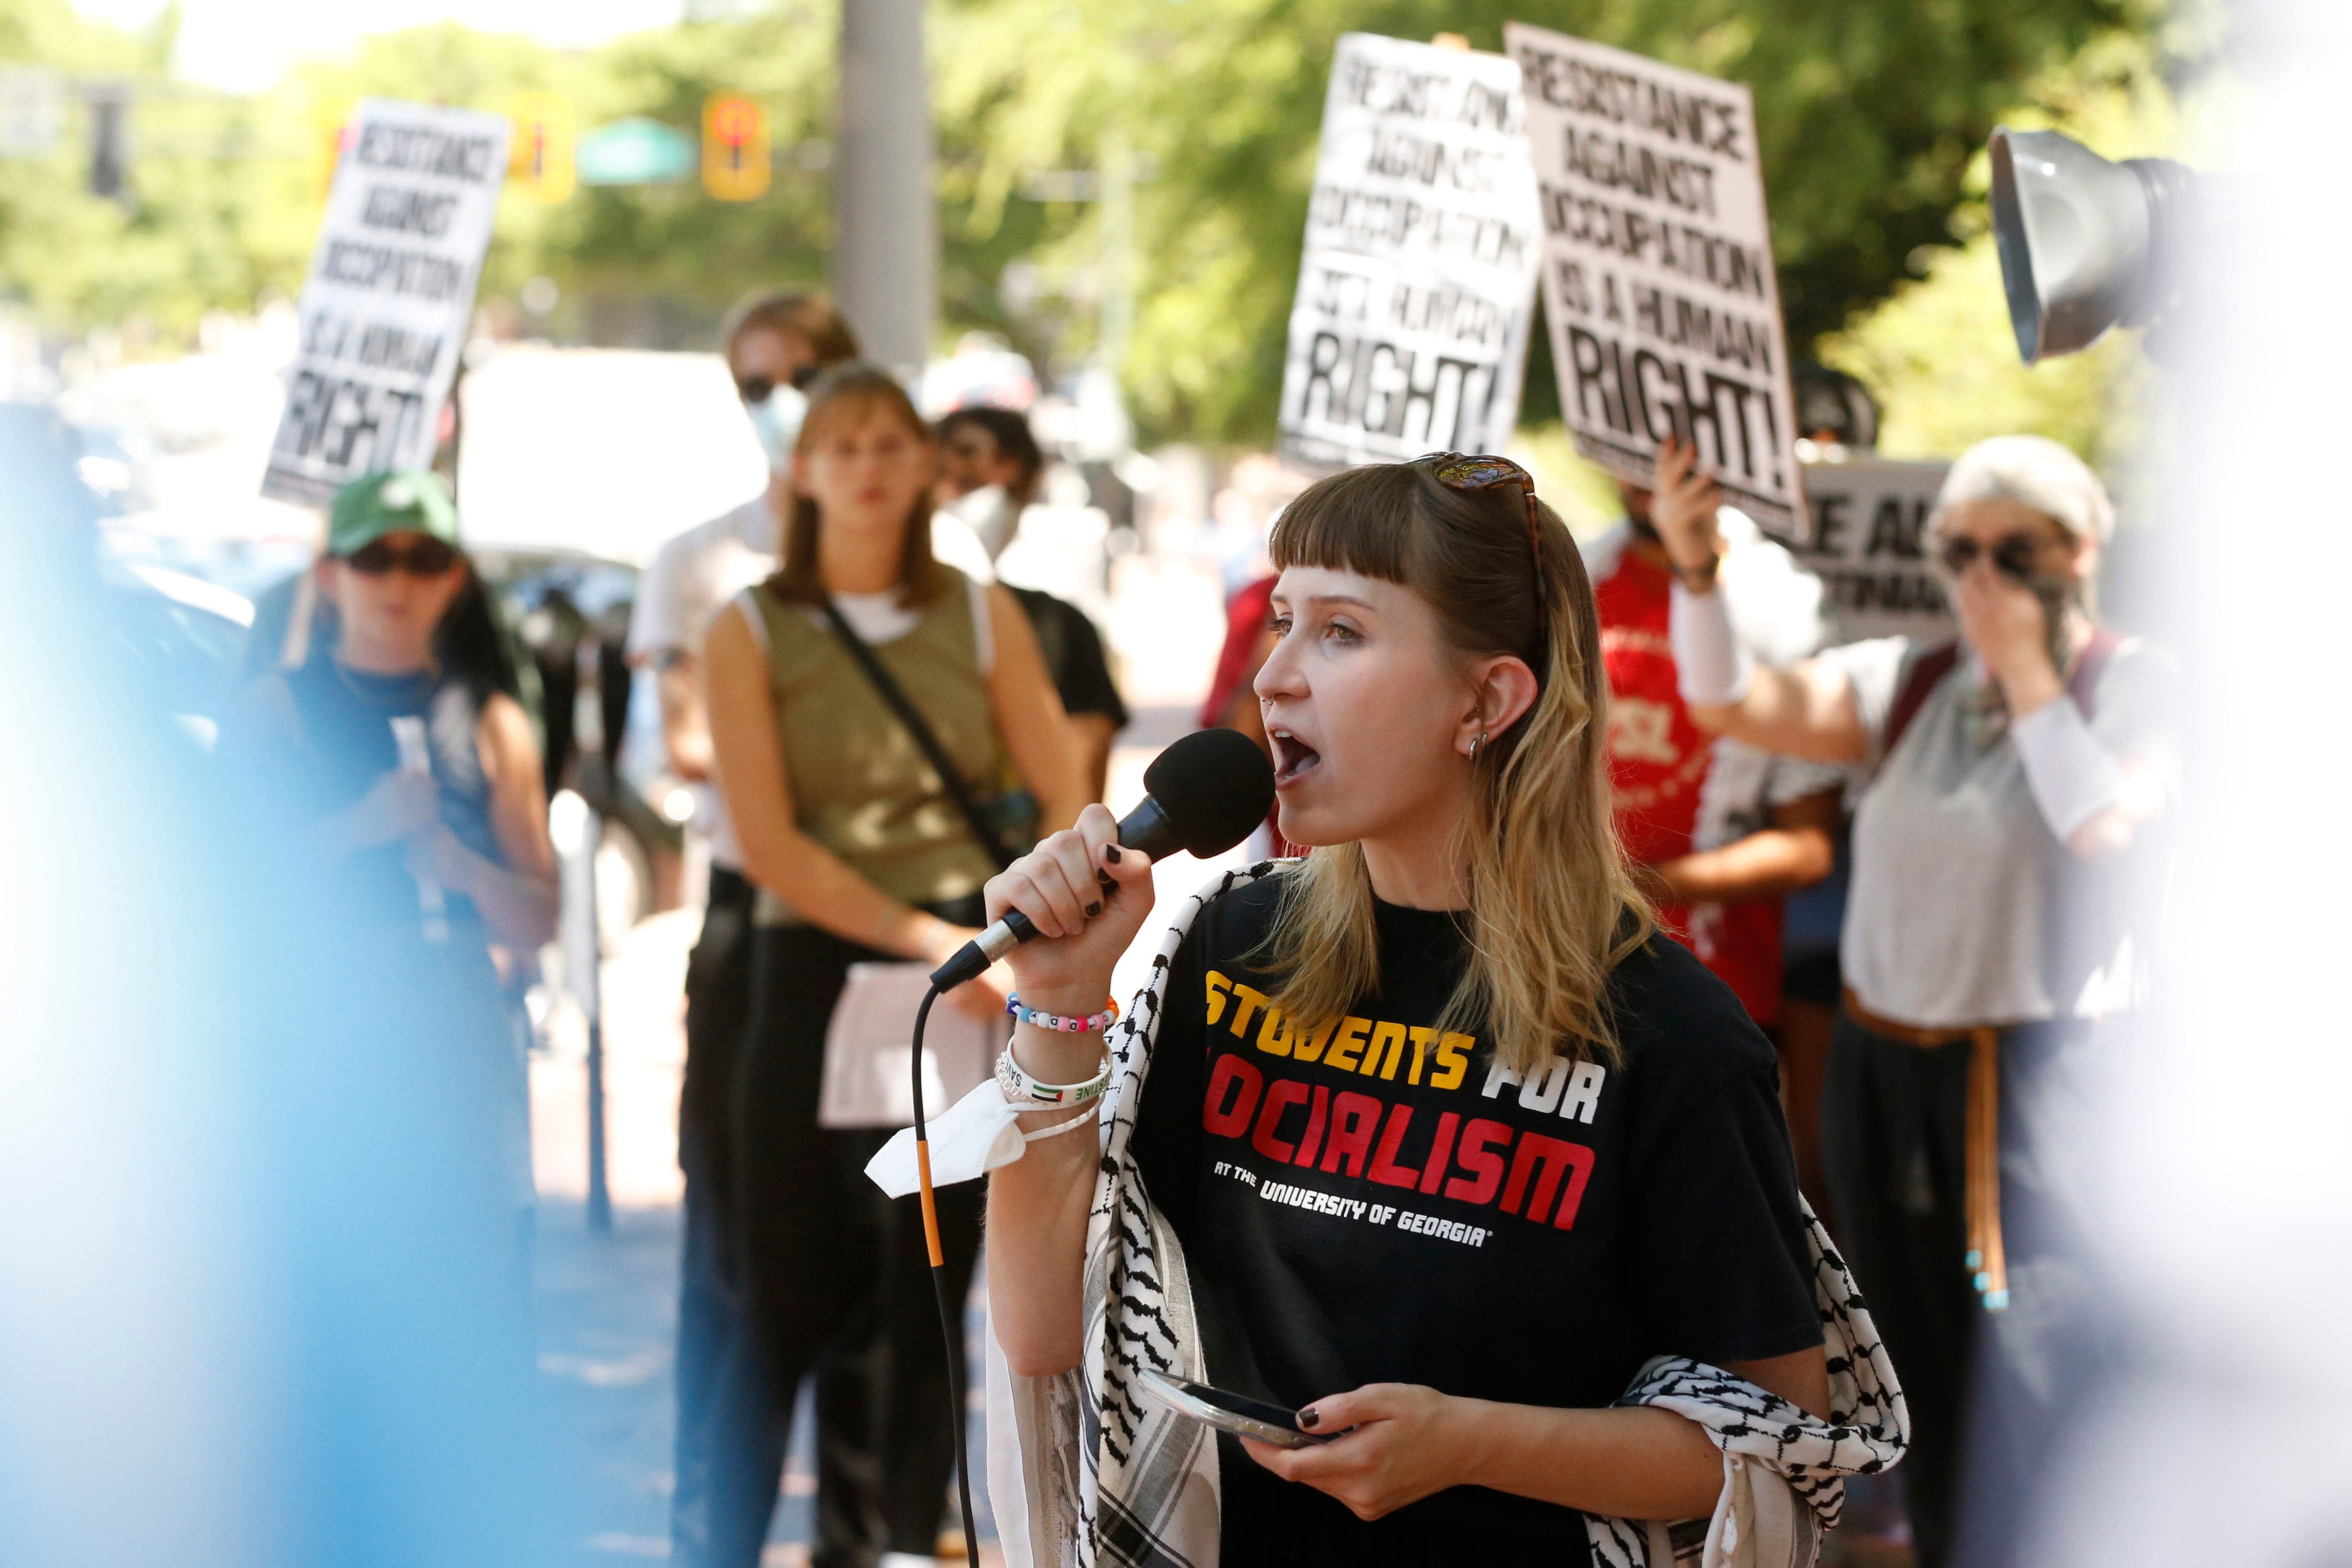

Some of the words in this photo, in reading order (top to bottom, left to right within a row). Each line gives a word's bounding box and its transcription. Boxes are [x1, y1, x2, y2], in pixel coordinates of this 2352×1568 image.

[1520, 43, 1745, 160] RESISTANCE
[1566, 126, 1715, 220] AGAINST
[1539, 181, 1766, 298] OCCUPATION
[1558, 256, 1591, 315] IS
[1602, 271, 1624, 324] A
[1633, 279, 1772, 376] HUMAN
[1303, 331, 1498, 456] RIGHT!
[1569, 325, 1783, 489] RIGHT!
[1205, 970, 1475, 1091] STUDENTS
[1481, 1052, 1606, 1124] FOR
[1203, 1046, 1596, 1231] OCIALISM
[1214, 1161, 1232, 1176] AT
[1234, 1166, 1257, 1188] THE
[1260, 1180, 1367, 1220] UNIVERSITY
[1368, 1204, 1397, 1225] OF
